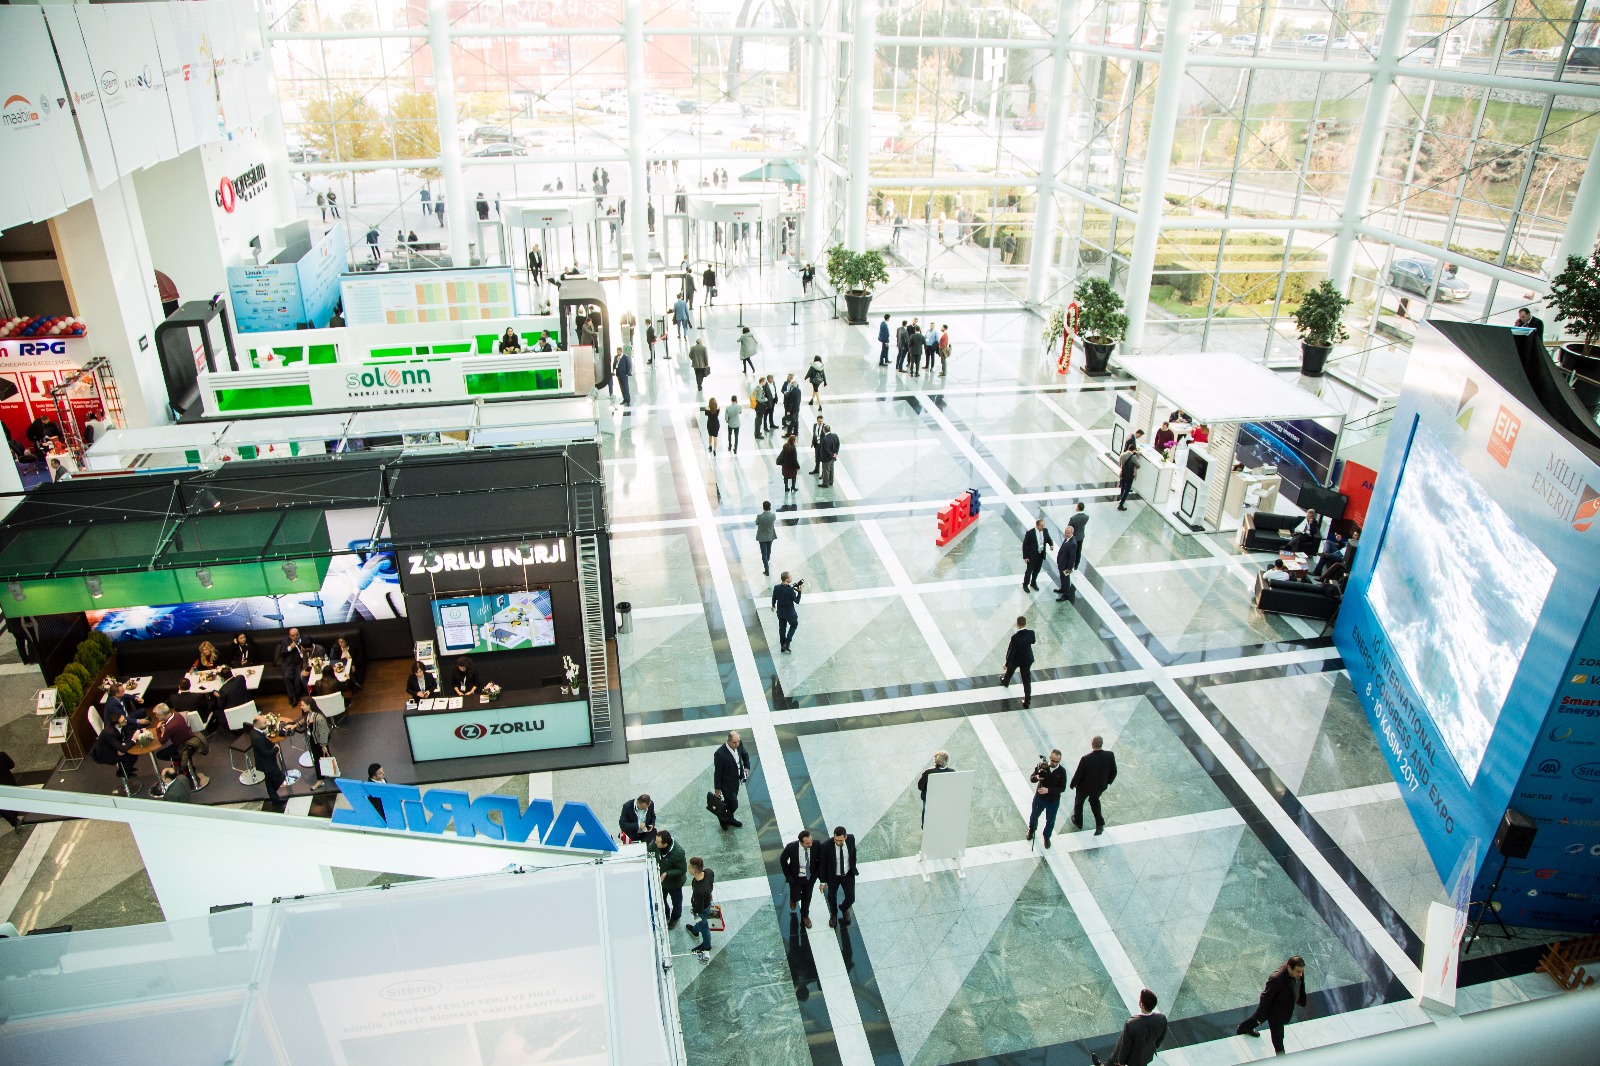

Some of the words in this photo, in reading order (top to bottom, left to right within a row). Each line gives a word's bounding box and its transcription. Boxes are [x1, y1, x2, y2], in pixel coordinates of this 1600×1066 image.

[19, 341, 65, 356] RPG
[1495, 411, 1519, 444] EIF
[1545, 451, 1585, 496] MİLLİ
[1531, 471, 1575, 523] ENERJİ
[489, 719, 546, 736] ZORLU
[1379, 648, 1436, 768] INTERNATIONAL
[1352, 624, 1377, 674] ENERGY
[1375, 672, 1412, 751] CONGRESS
[1410, 750, 1429, 786] AND
[1428, 783, 1454, 835] EXPO
[1380, 718, 1402, 763] KASIM
[1400, 757, 1420, 793] 2017
[380, 1004, 434, 1019] ANAHTAR
[512, 994, 527, 1003] VE
[386, 982, 437, 998] Siterm
